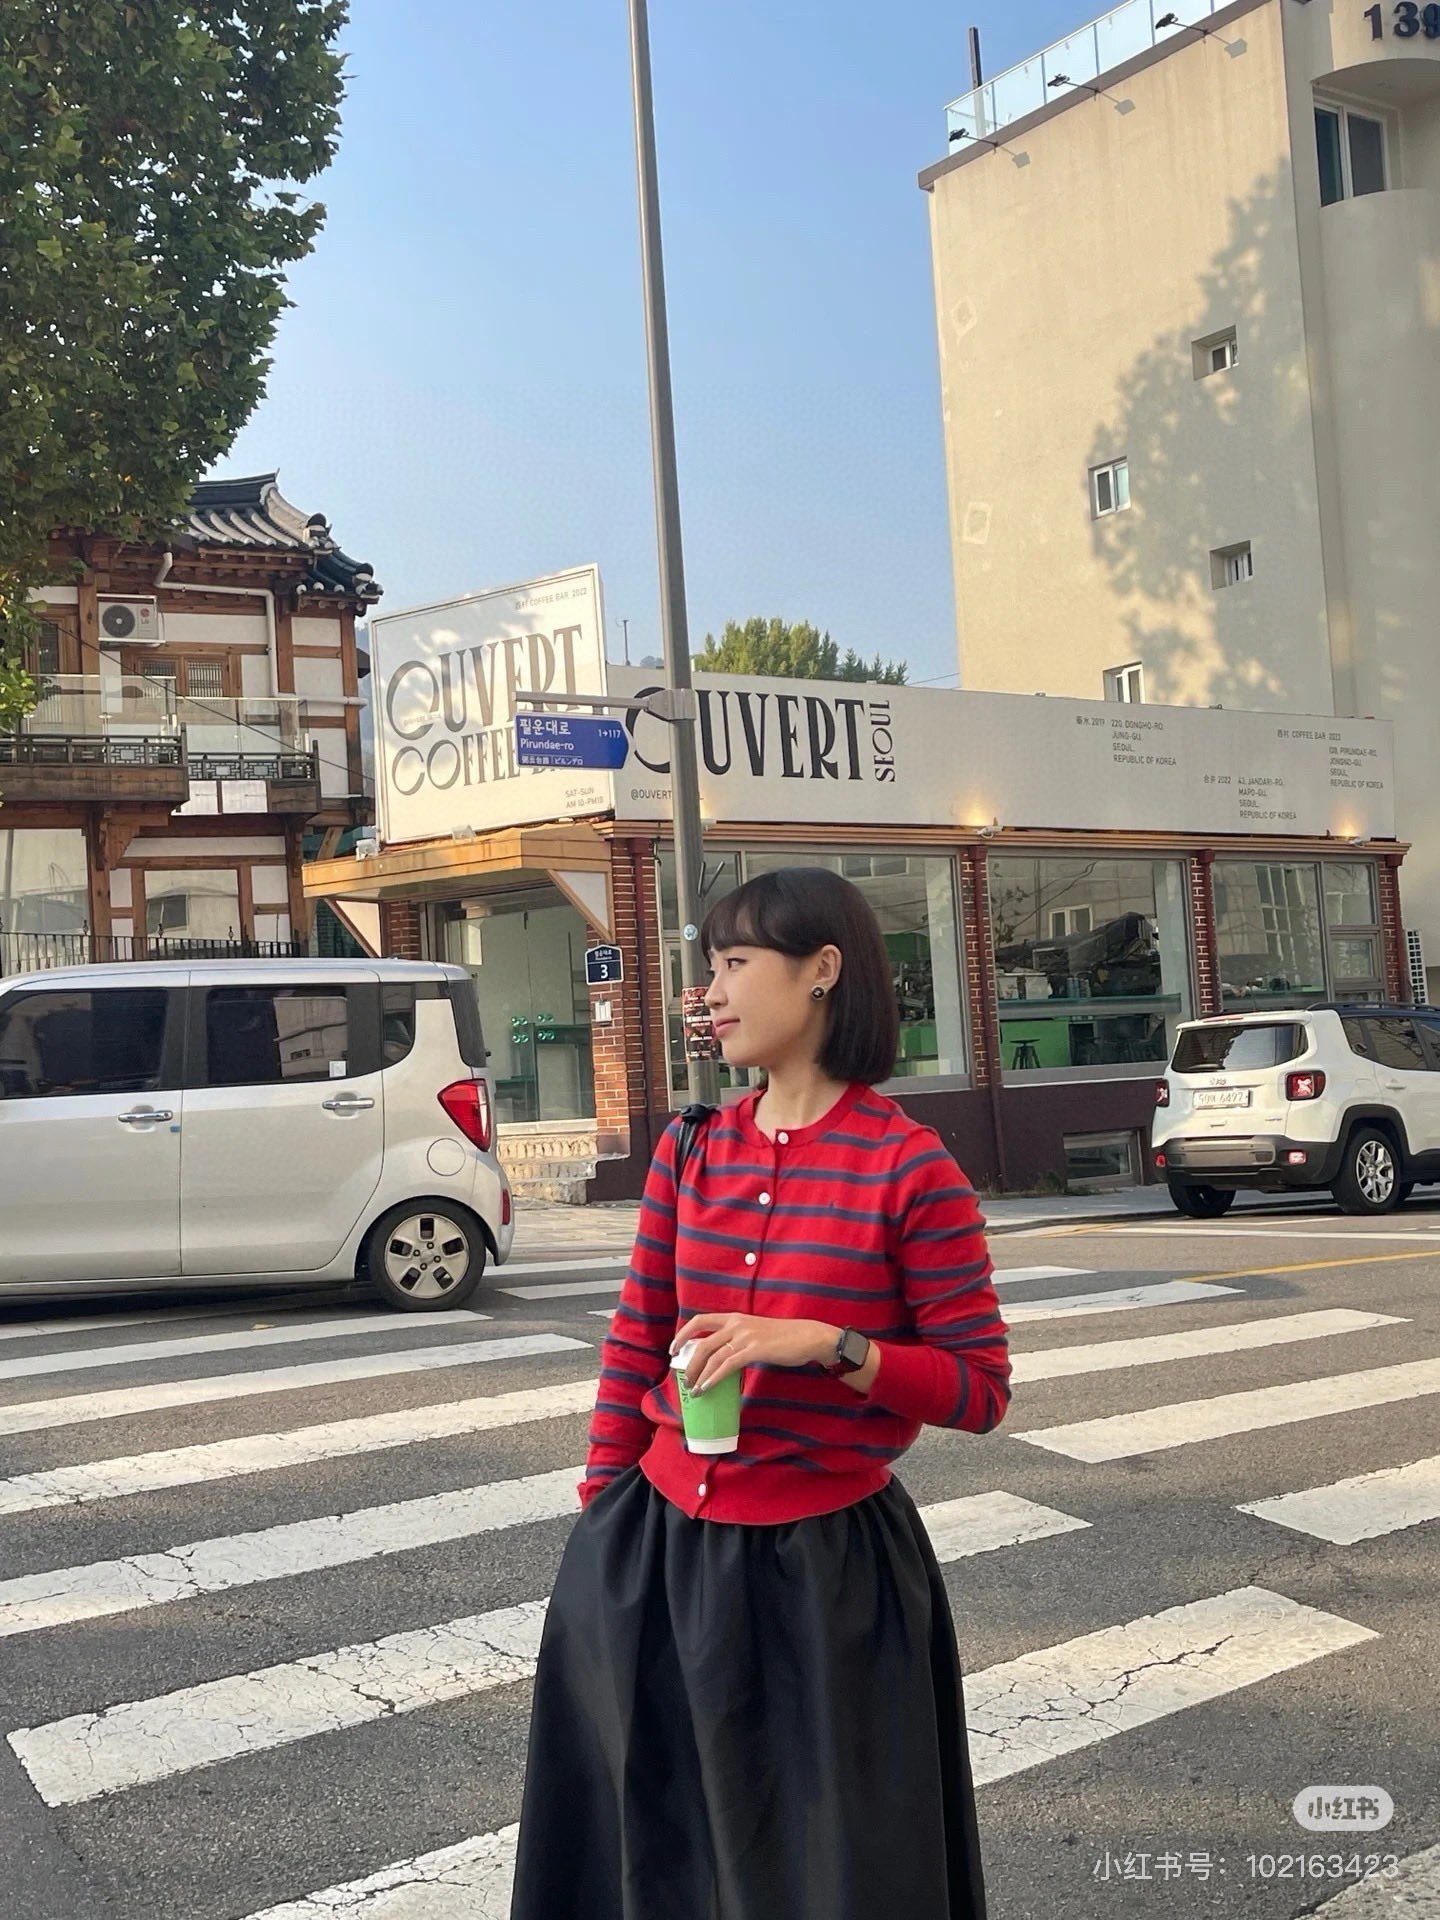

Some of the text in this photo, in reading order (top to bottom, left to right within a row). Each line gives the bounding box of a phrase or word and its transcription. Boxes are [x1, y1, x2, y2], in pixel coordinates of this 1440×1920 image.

[386, 624, 583, 741] OUVERT
[519, 718, 572, 736] 필운대로
[869, 699, 895, 783] SEOUL
[1291, 730, 1313, 740] COFFEE
[1314, 732, 1326, 740] BAR
[520, 738, 575, 751] Pirundae-ro
[1113, 754, 1177, 766] REPUBLIC OF KOREA
[1330, 778, 1384, 789] REPUBLIC OF KOREA
[1239, 809, 1297, 820] REPUBLIC OF KOREA
[600, 964, 609, 979] 3
